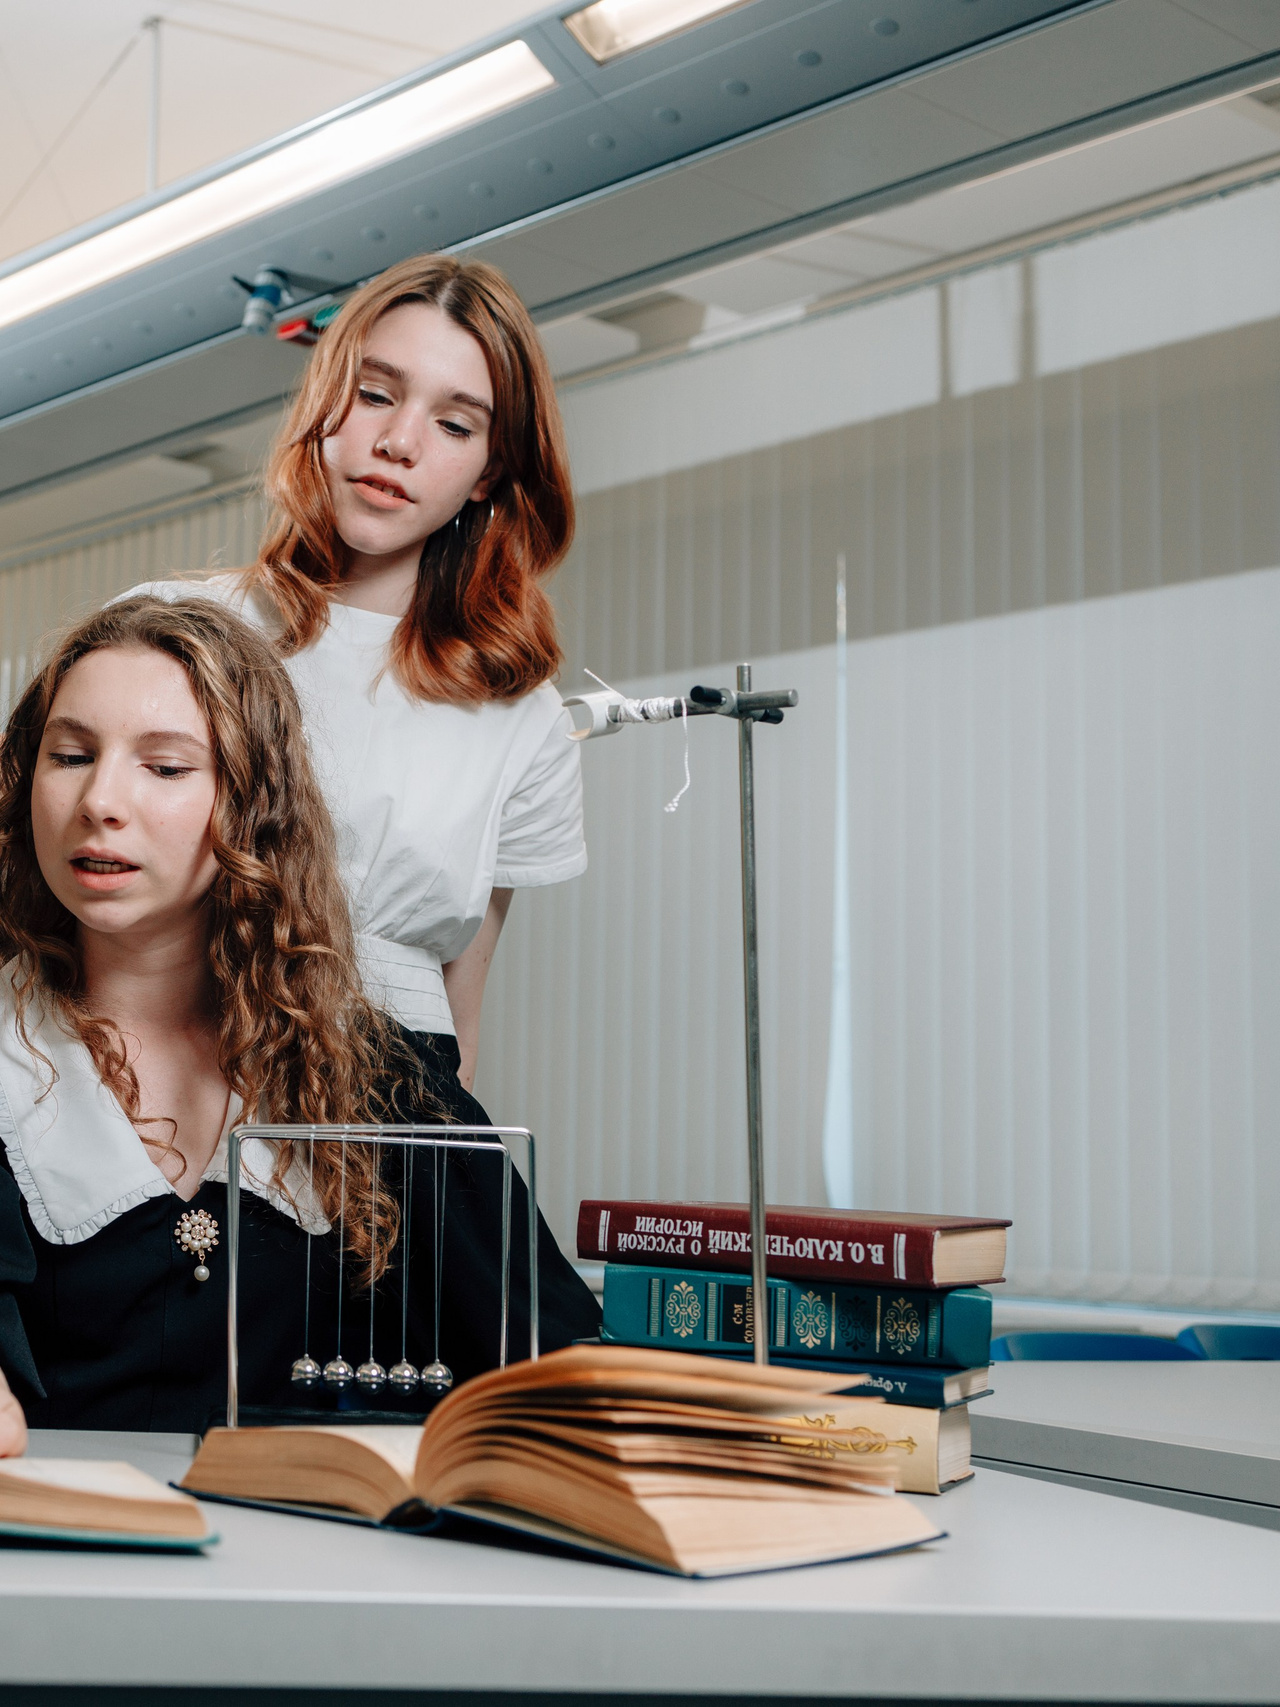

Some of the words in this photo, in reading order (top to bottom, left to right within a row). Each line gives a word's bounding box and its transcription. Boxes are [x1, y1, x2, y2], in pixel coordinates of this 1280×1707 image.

[634, 1215, 704, 1238] ИСТОРИИ
[617, 1232, 685, 1255] РУССКОЙ
[690, 1239, 702, 1256] О
